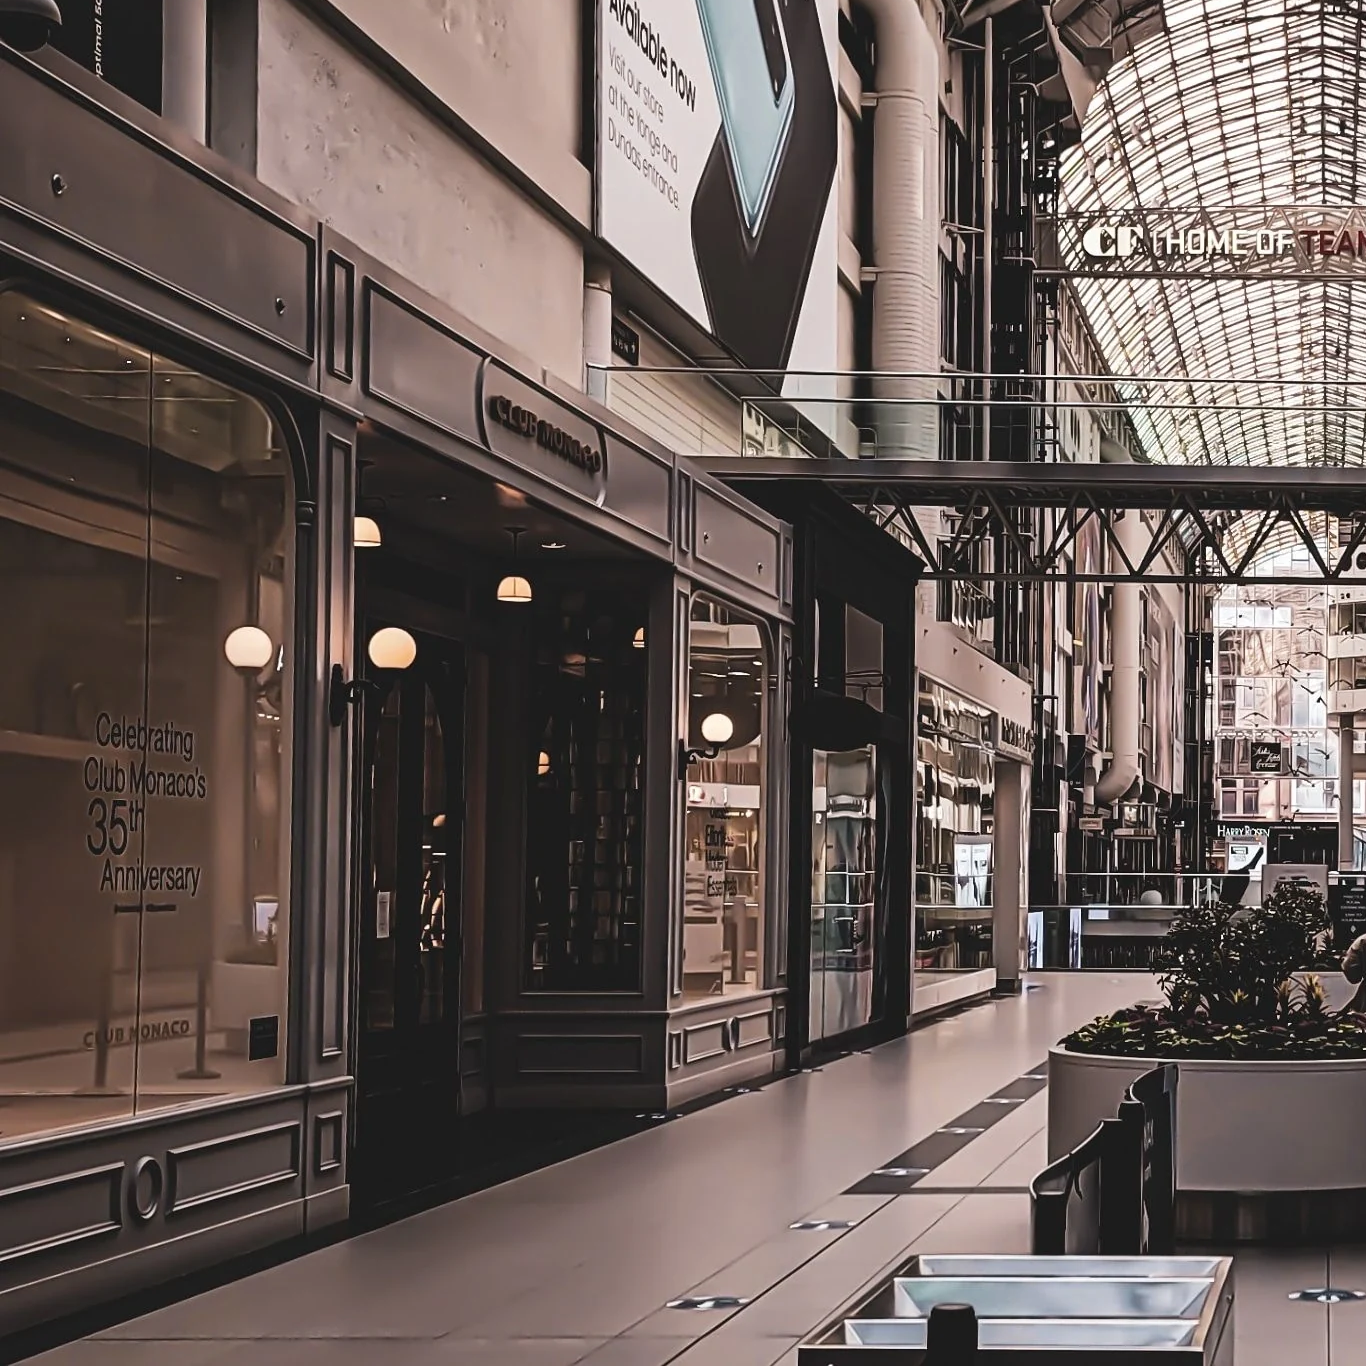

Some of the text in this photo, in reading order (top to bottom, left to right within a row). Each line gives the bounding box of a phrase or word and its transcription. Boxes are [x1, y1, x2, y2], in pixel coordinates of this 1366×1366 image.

[94, 18, 103, 78] ptimal
[608, 41, 664, 123] Visit our store
[670, 57, 697, 113] now
[608, 84, 619, 109] at
[620, 93, 635, 127] the
[662, 141, 678, 174] and
[608, 116, 680, 211] Dundas entrance.
[1083, 226, 1143, 257] CF
[1165, 229, 1249, 255] HOME
[1256, 229, 1295, 256] OF
[489, 394, 601, 474] CLUB MONACO
[95, 711, 195, 763] Celebrating
[84, 756, 206, 799] Club Monaco's
[87, 797, 145, 856] 35th
[100, 857, 201, 898] Anniversary
